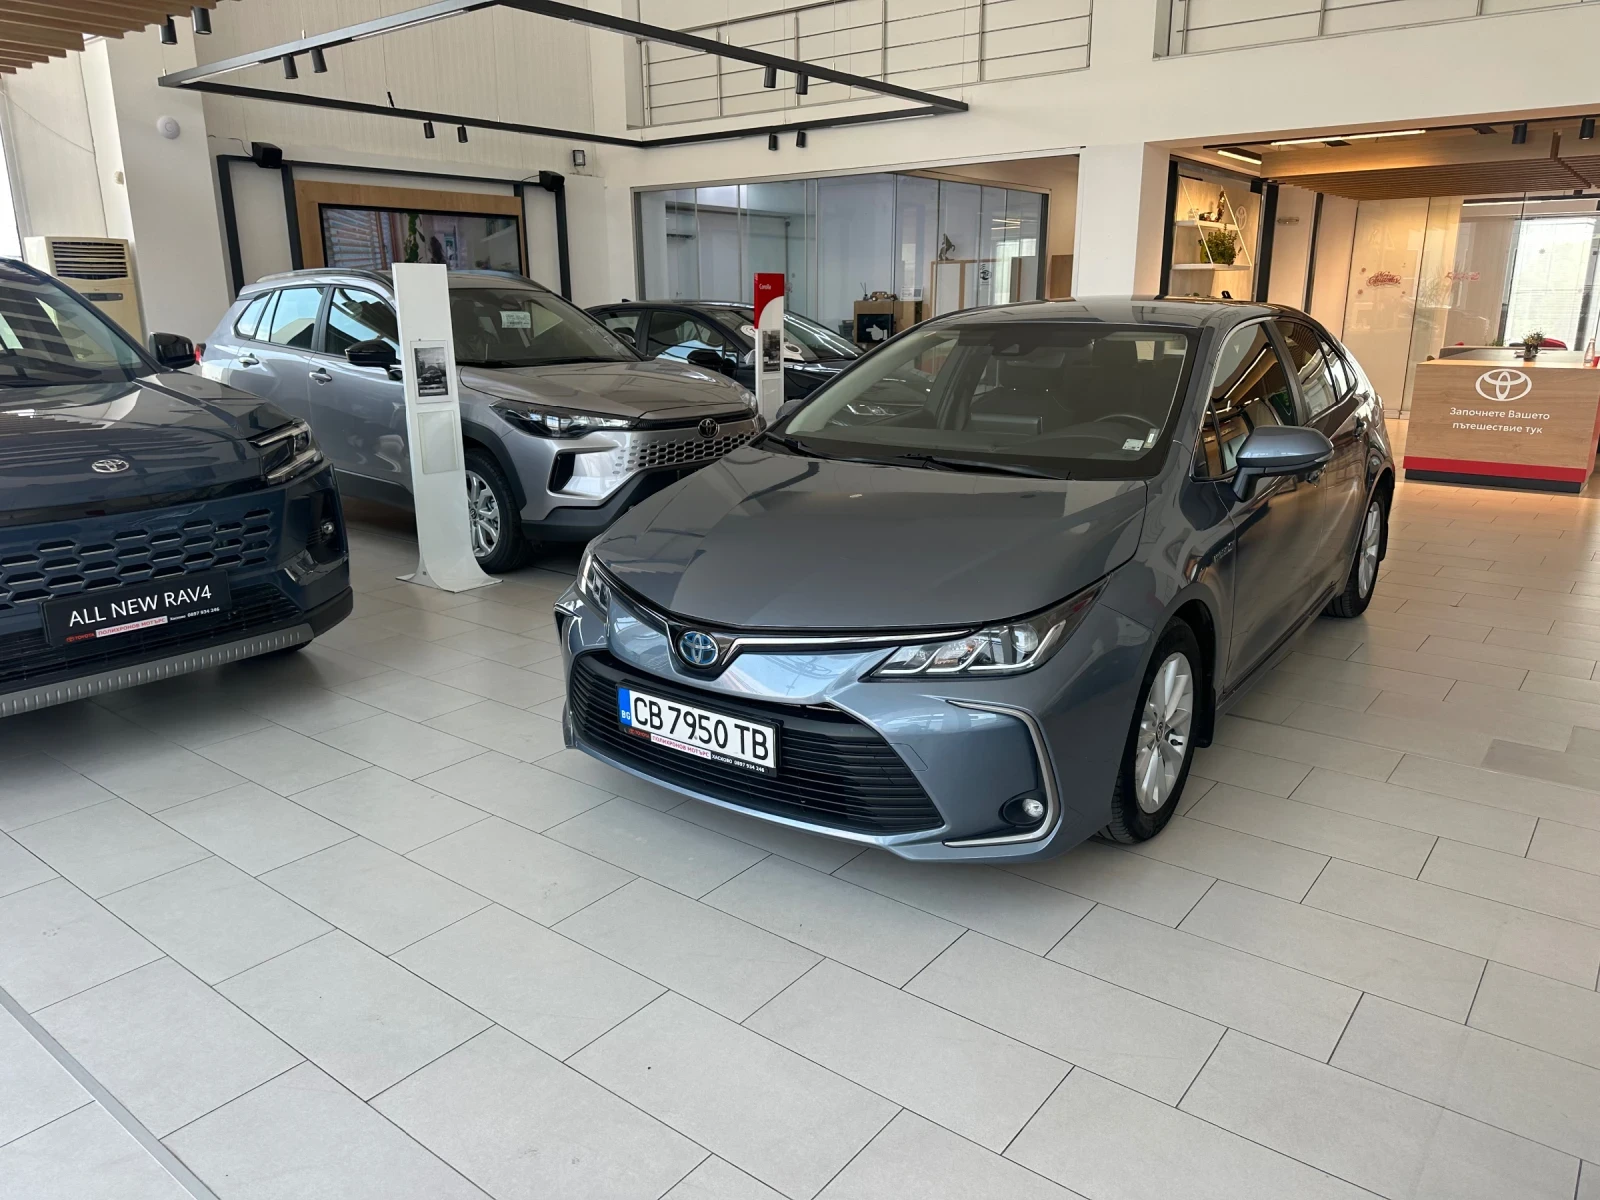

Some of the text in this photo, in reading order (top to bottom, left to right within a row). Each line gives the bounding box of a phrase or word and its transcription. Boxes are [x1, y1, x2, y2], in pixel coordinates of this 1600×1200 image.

[1450, 407, 1550, 420] Започнете Вашето
[1452, 422, 1543, 435] пътешествие тук
[69, 584, 212, 627] ALL NEW RAV4
[74, 632, 95, 641] TOYOTA
[98, 623, 140, 636] ПОЛИХРОНОВ
[141, 617, 166, 627] МОТЪРС
[621, 709, 631, 721] BG
[633, 696, 769, 761] CB 7950 TB
[652, 735, 687, 751] ПОЛИХРОНОВ
[687, 746, 710, 758] МОТЪРС
[711, 754, 733, 764] ХАСКОВО
